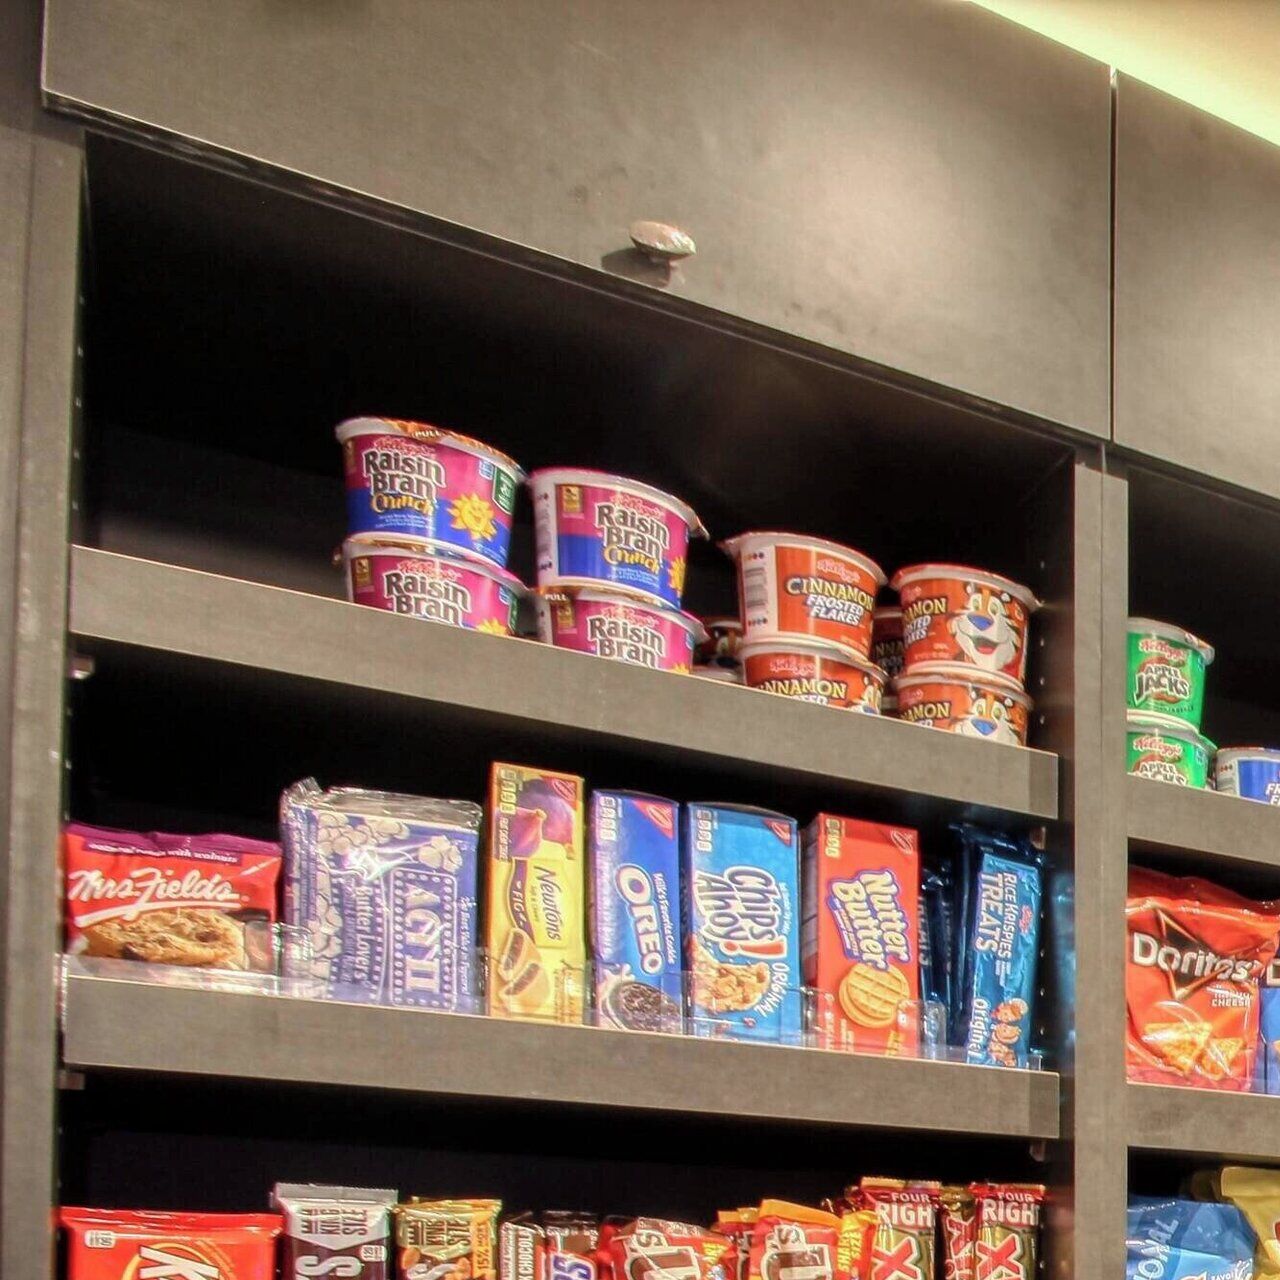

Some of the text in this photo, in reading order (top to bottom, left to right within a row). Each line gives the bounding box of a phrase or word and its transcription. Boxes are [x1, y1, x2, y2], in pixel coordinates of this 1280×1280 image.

[363, 449, 446, 487] Raisin
[370, 472, 437, 501] Bran
[370, 492, 432, 517] Crunch
[595, 503, 670, 546] Raisin
[603, 524, 664, 563] Bran
[603, 545, 660, 575] Crunch
[383, 571, 472, 613] Raisin
[785, 576, 875, 610] CINNAMON
[805, 592, 865, 618] FROSTED
[392, 595, 463, 628] Bran
[809, 605, 862, 627] FLAKES
[586, 616, 667, 659] Raisin
[594, 641, 659, 669] Bran
[1133, 673, 1191, 706] JACKS
[1145, 664, 1182, 680] APPLE
[1139, 761, 1177, 774] APPLE
[132, 867, 242, 921] Fields
[512, 889, 525, 912] FIG
[533, 864, 562, 942] Newtons
[723, 865, 781, 942] Chips
[354, 885, 376, 981] Butter Lovers
[614, 863, 665, 976] OREO
[831, 880, 889, 971] Butter
[860, 870, 910, 962] Nutter
[975, 872, 1004, 956] TREATS
[996, 872, 1019, 964] RICE KRISPIES
[1132, 931, 1252, 983] Doritos
[753, 962, 791, 1018] ORIGINAL
[967, 997, 991, 1058] Original
[891, 1192, 931, 1202] FOUR
[997, 1191, 1035, 1202] FOUR
[320, 1207, 341, 1236] KING
[341, 1208, 369, 1236] SIZE
[837, 1230, 850, 1272] SHARE
[848, 1231, 861, 1260] SIZE
